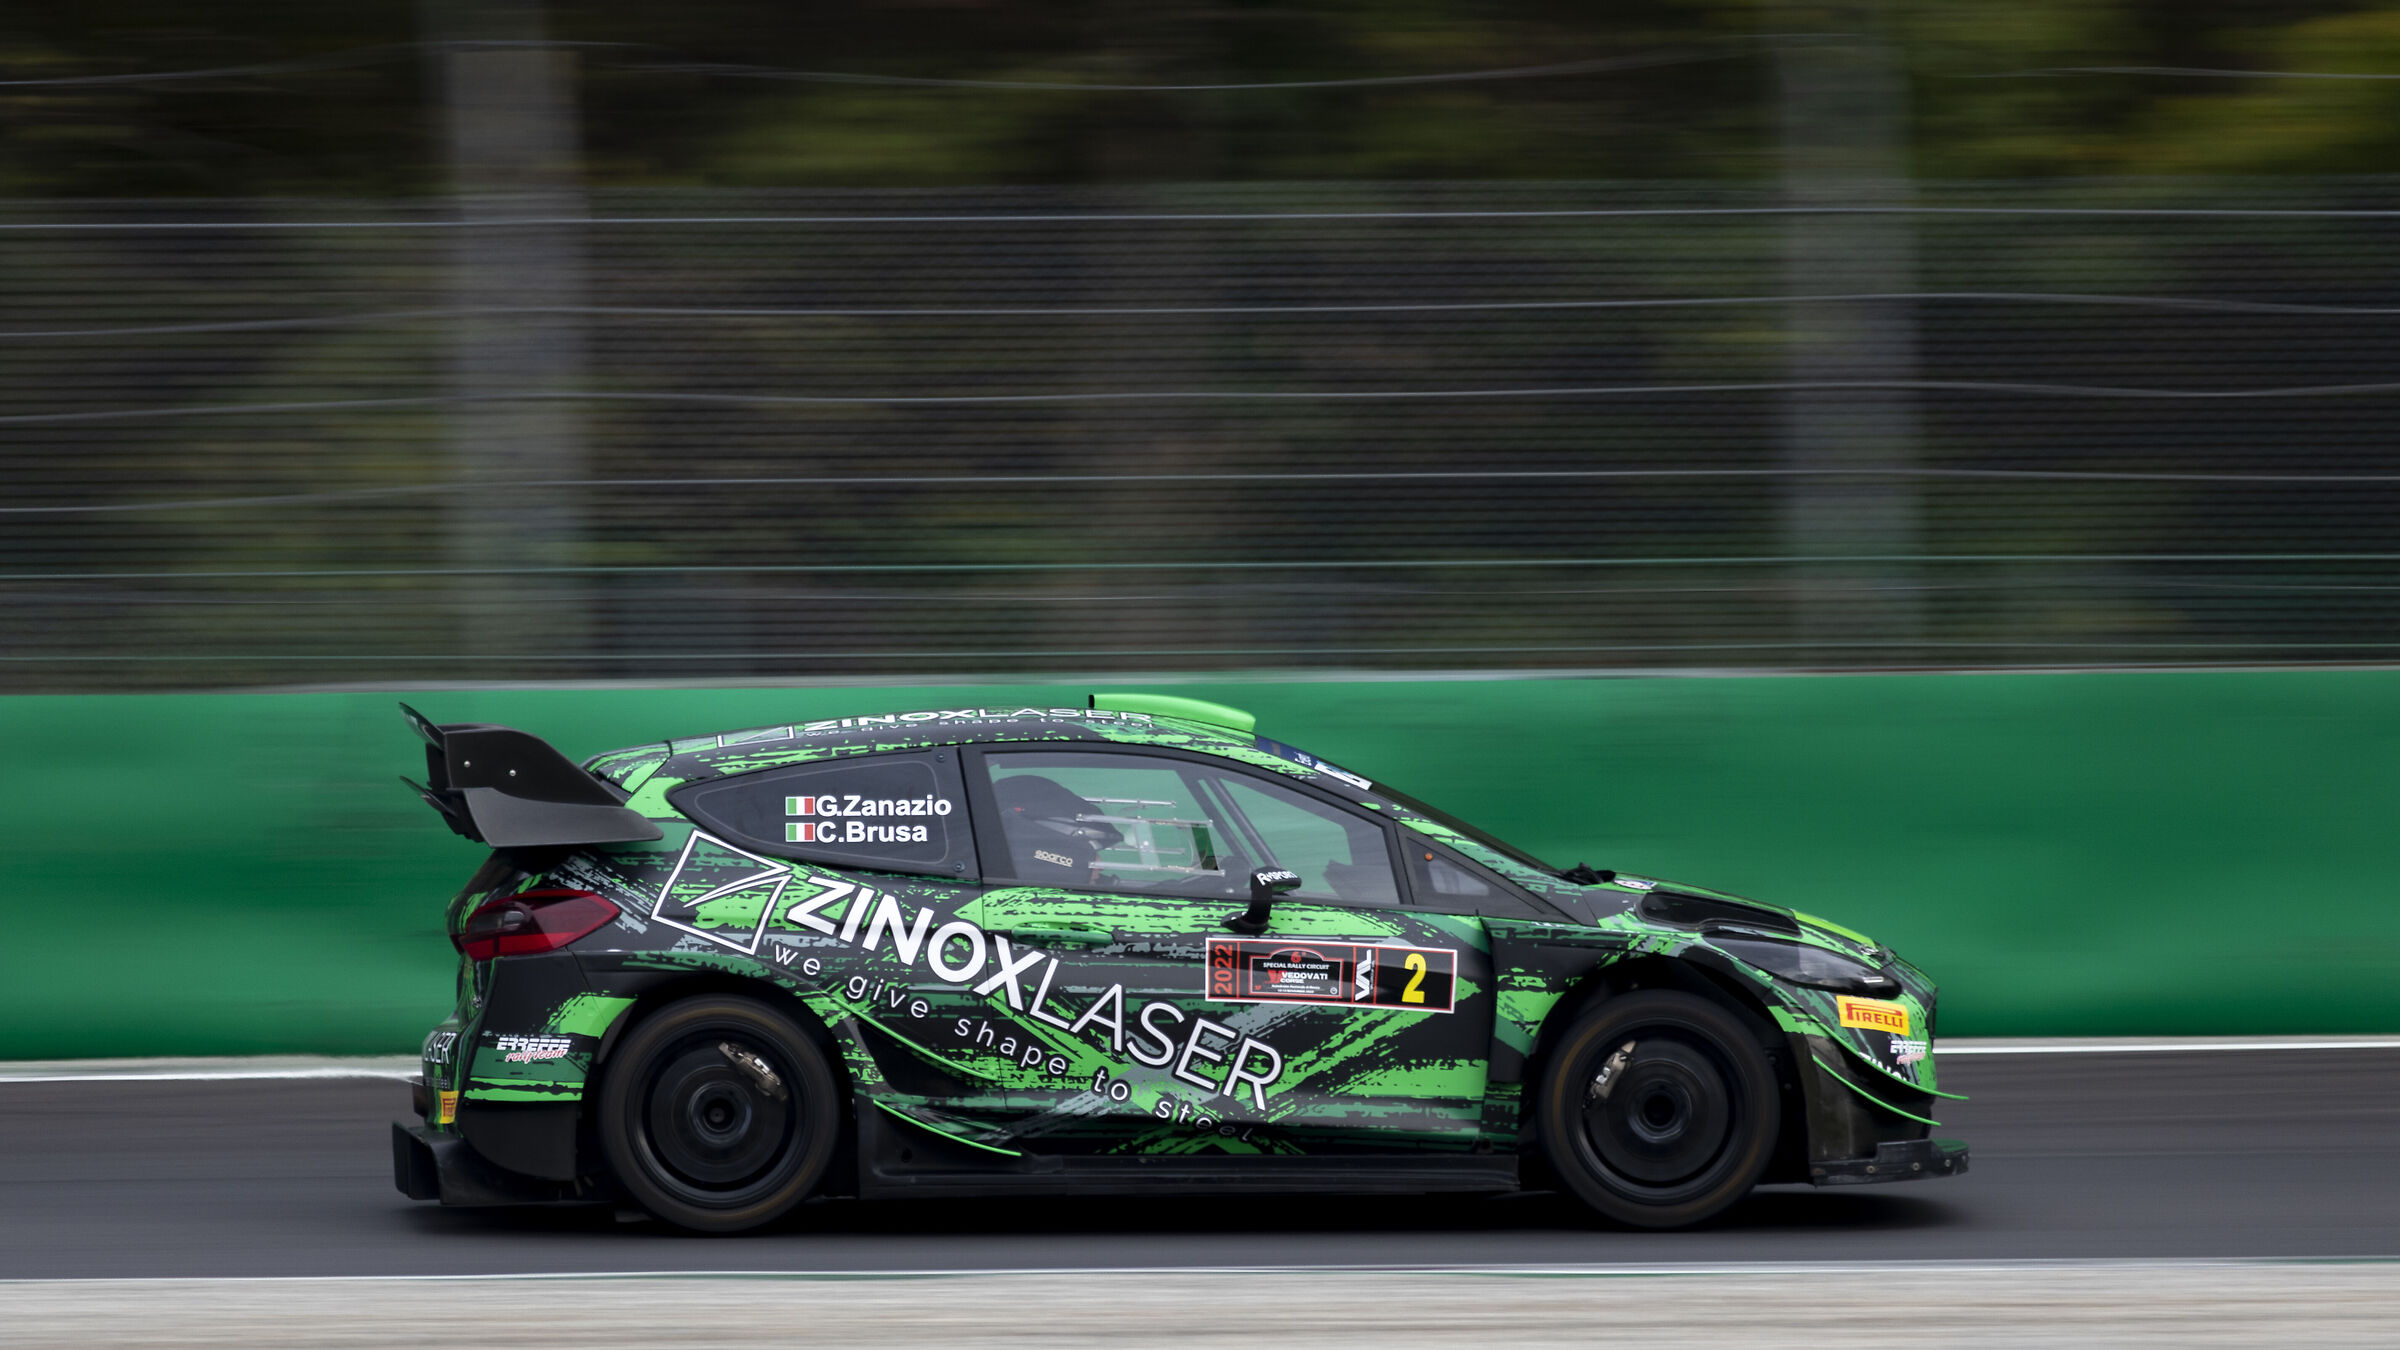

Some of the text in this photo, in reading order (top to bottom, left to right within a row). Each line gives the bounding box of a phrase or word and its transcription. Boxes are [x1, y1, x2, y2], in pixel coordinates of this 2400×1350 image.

[804, 708, 1151, 732] ZINOXLASER
[815, 794, 952, 817] G.Zanazio
[815, 821, 928, 843] C.Brusa
[1214, 944, 1233, 995] 2022
[1281, 971, 1328, 981] VEDOVATI
[1402, 953, 1427, 1004] 2
[787, 875, 1281, 1111] ZINOXLASER
[1845, 1002, 1903, 1029] PIRELLI
[774, 944, 1253, 1142] we give shape to steel
